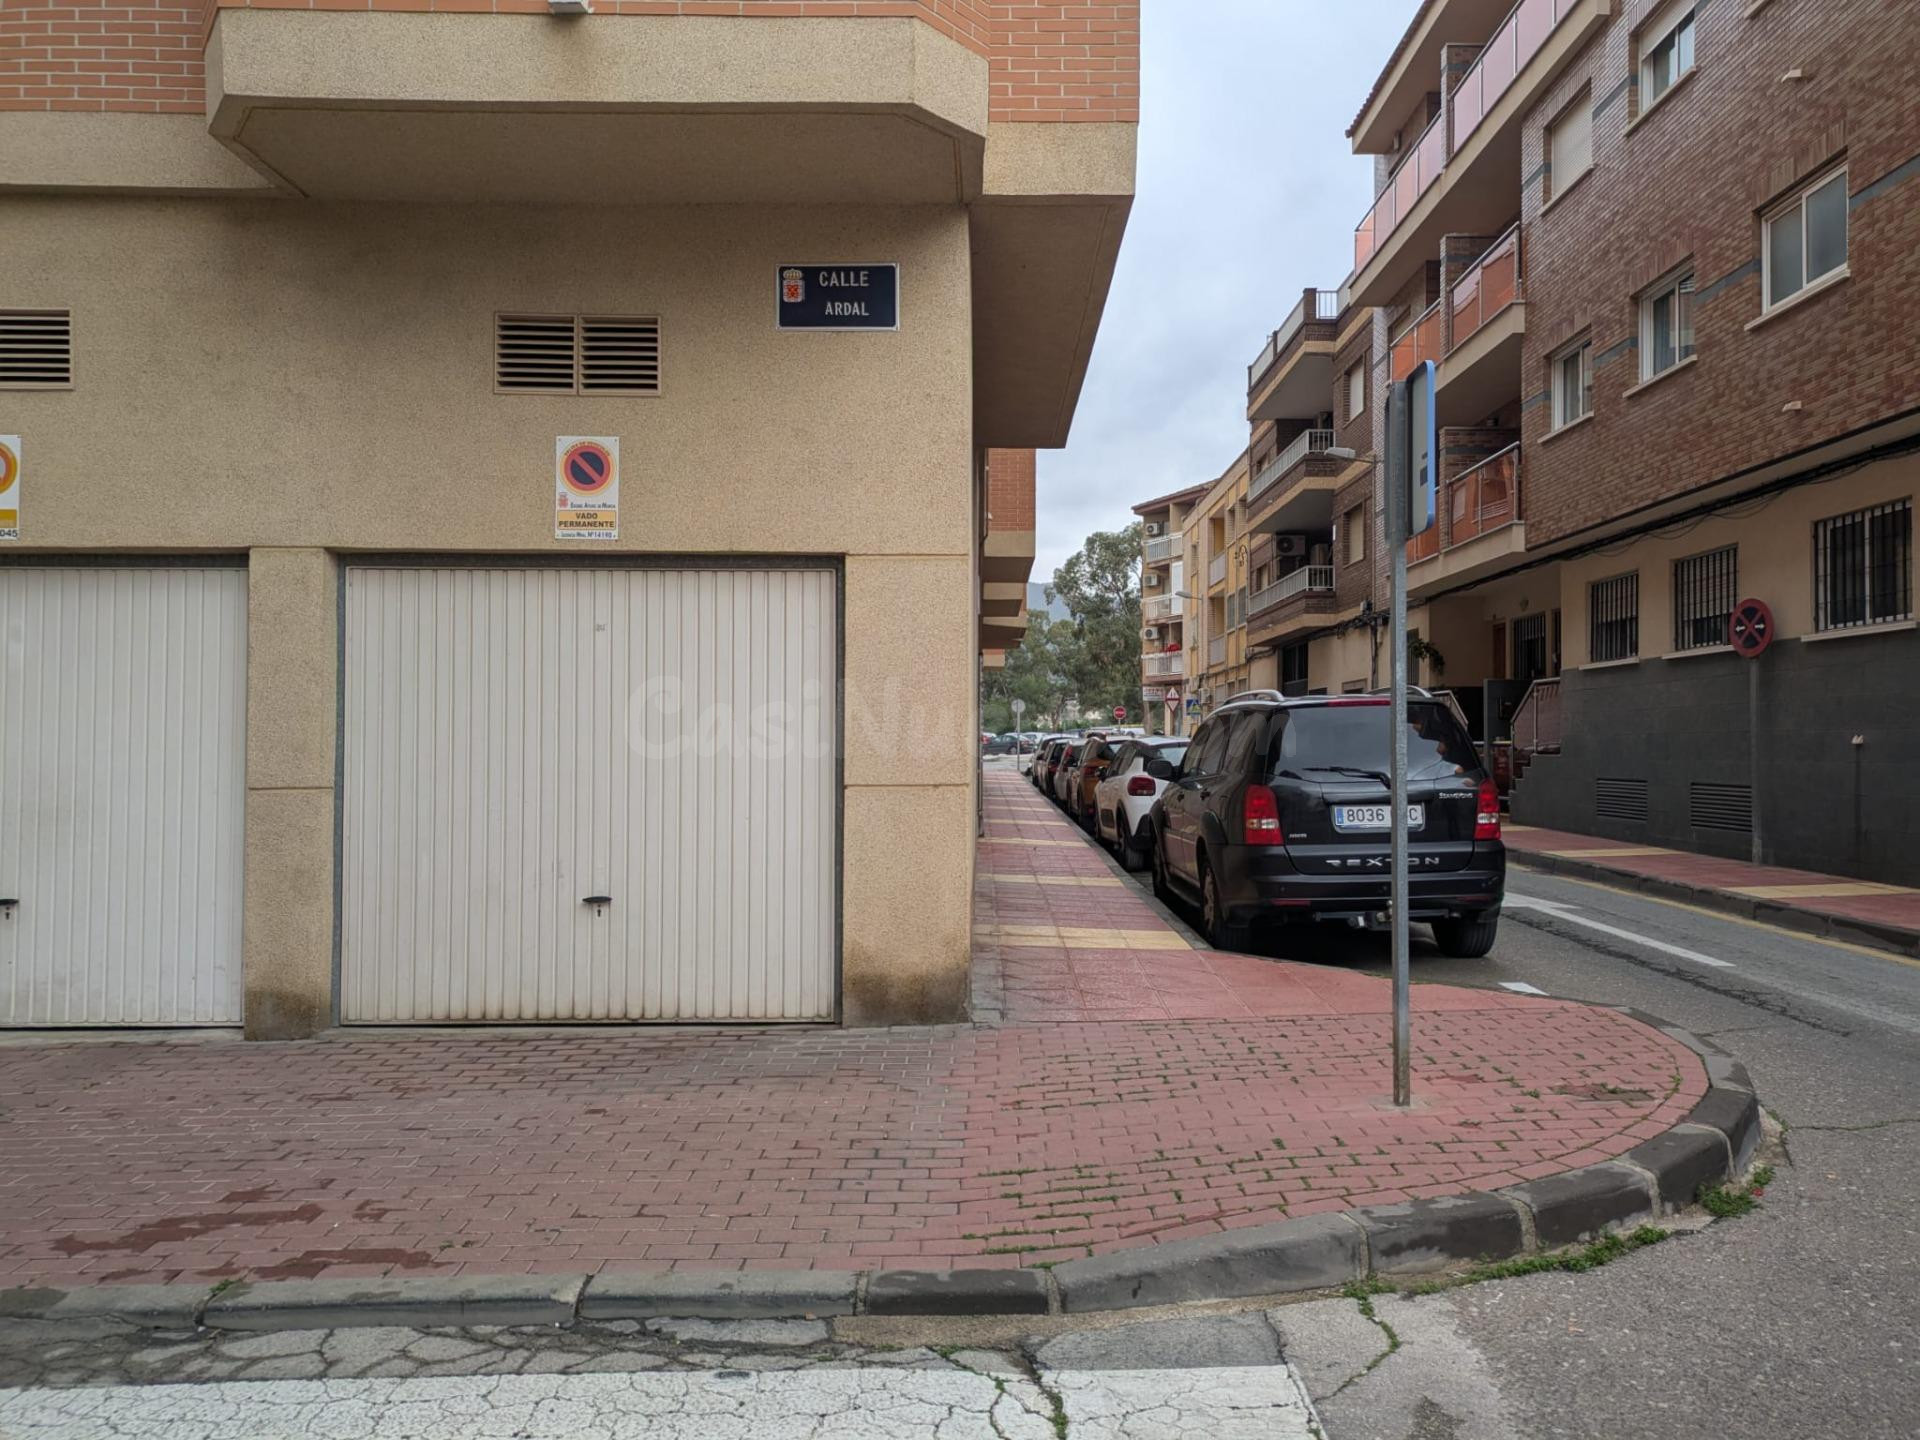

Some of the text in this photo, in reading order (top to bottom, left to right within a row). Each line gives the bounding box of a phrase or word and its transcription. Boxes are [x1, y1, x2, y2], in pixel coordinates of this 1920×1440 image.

[819, 271, 870, 287] CALLE
[825, 302, 870, 316] ARDAL
[575, 512, 598, 520] VADO
[558, 520, 615, 528] PERMANENTE
[1346, 808, 1385, 822] 8036
